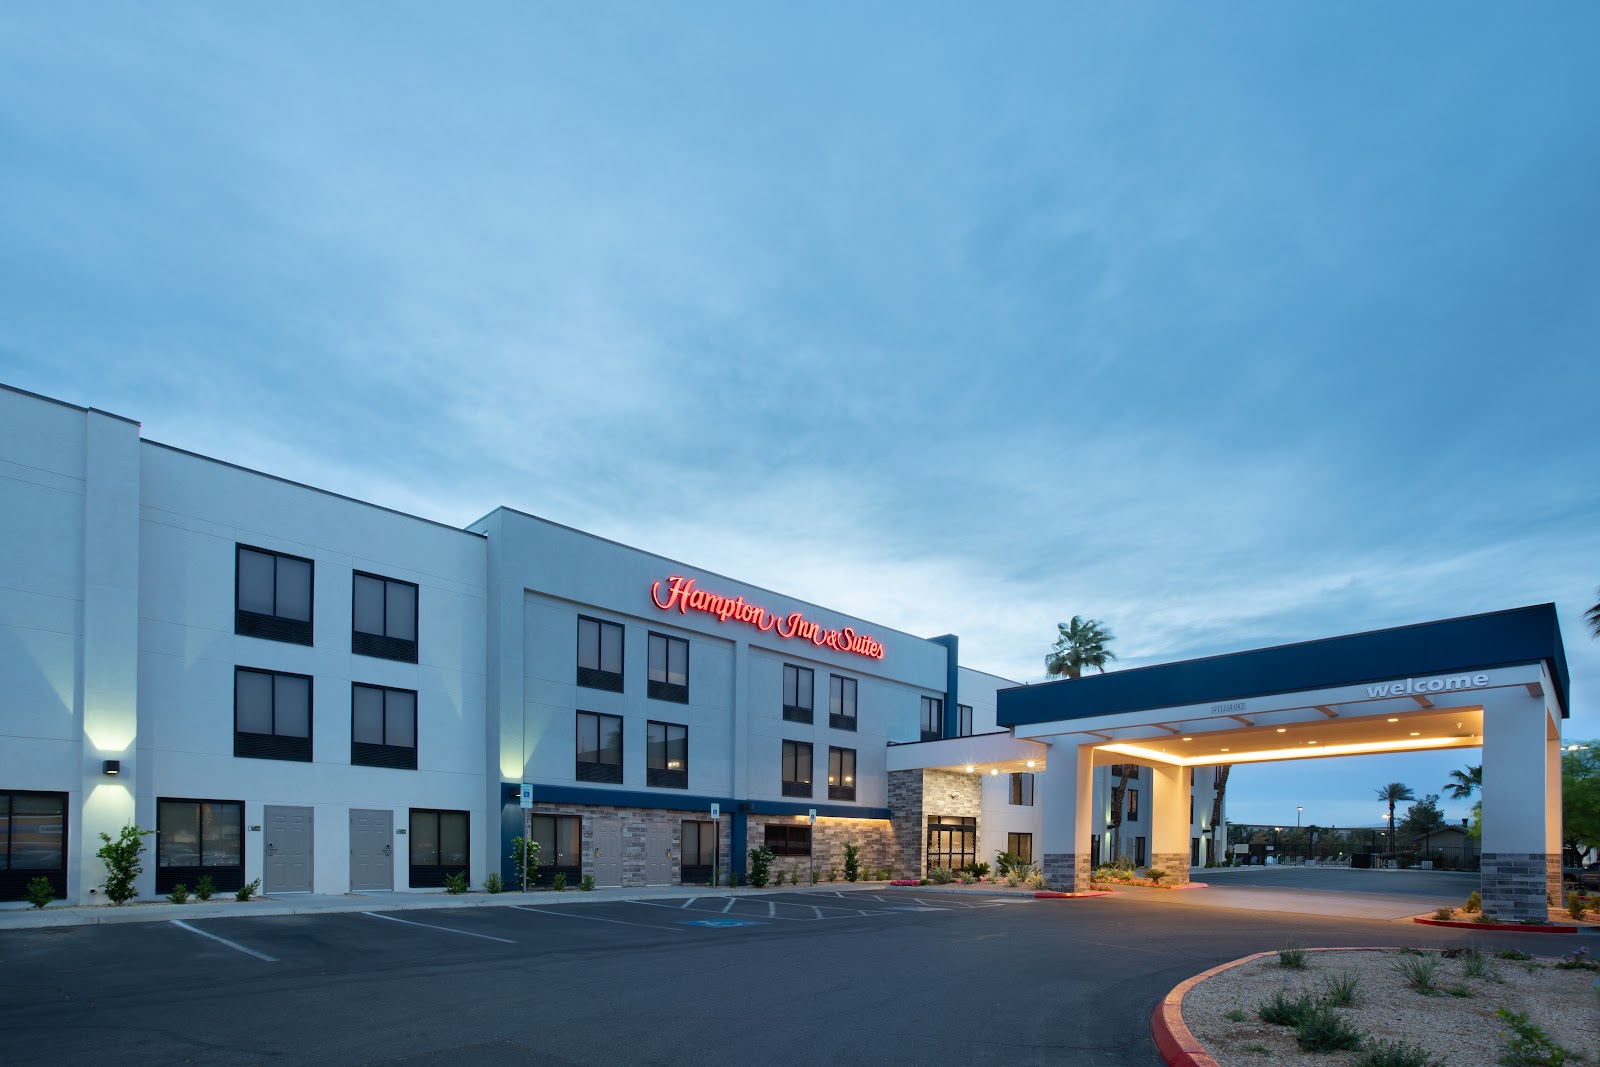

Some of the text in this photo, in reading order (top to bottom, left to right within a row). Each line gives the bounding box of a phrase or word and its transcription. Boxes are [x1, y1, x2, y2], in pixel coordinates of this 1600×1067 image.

[651, 576, 775, 631] Hampton
[775, 613, 827, 646] Inn
[837, 627, 885, 660] Suites
[1366, 673, 1489, 698] welcome
